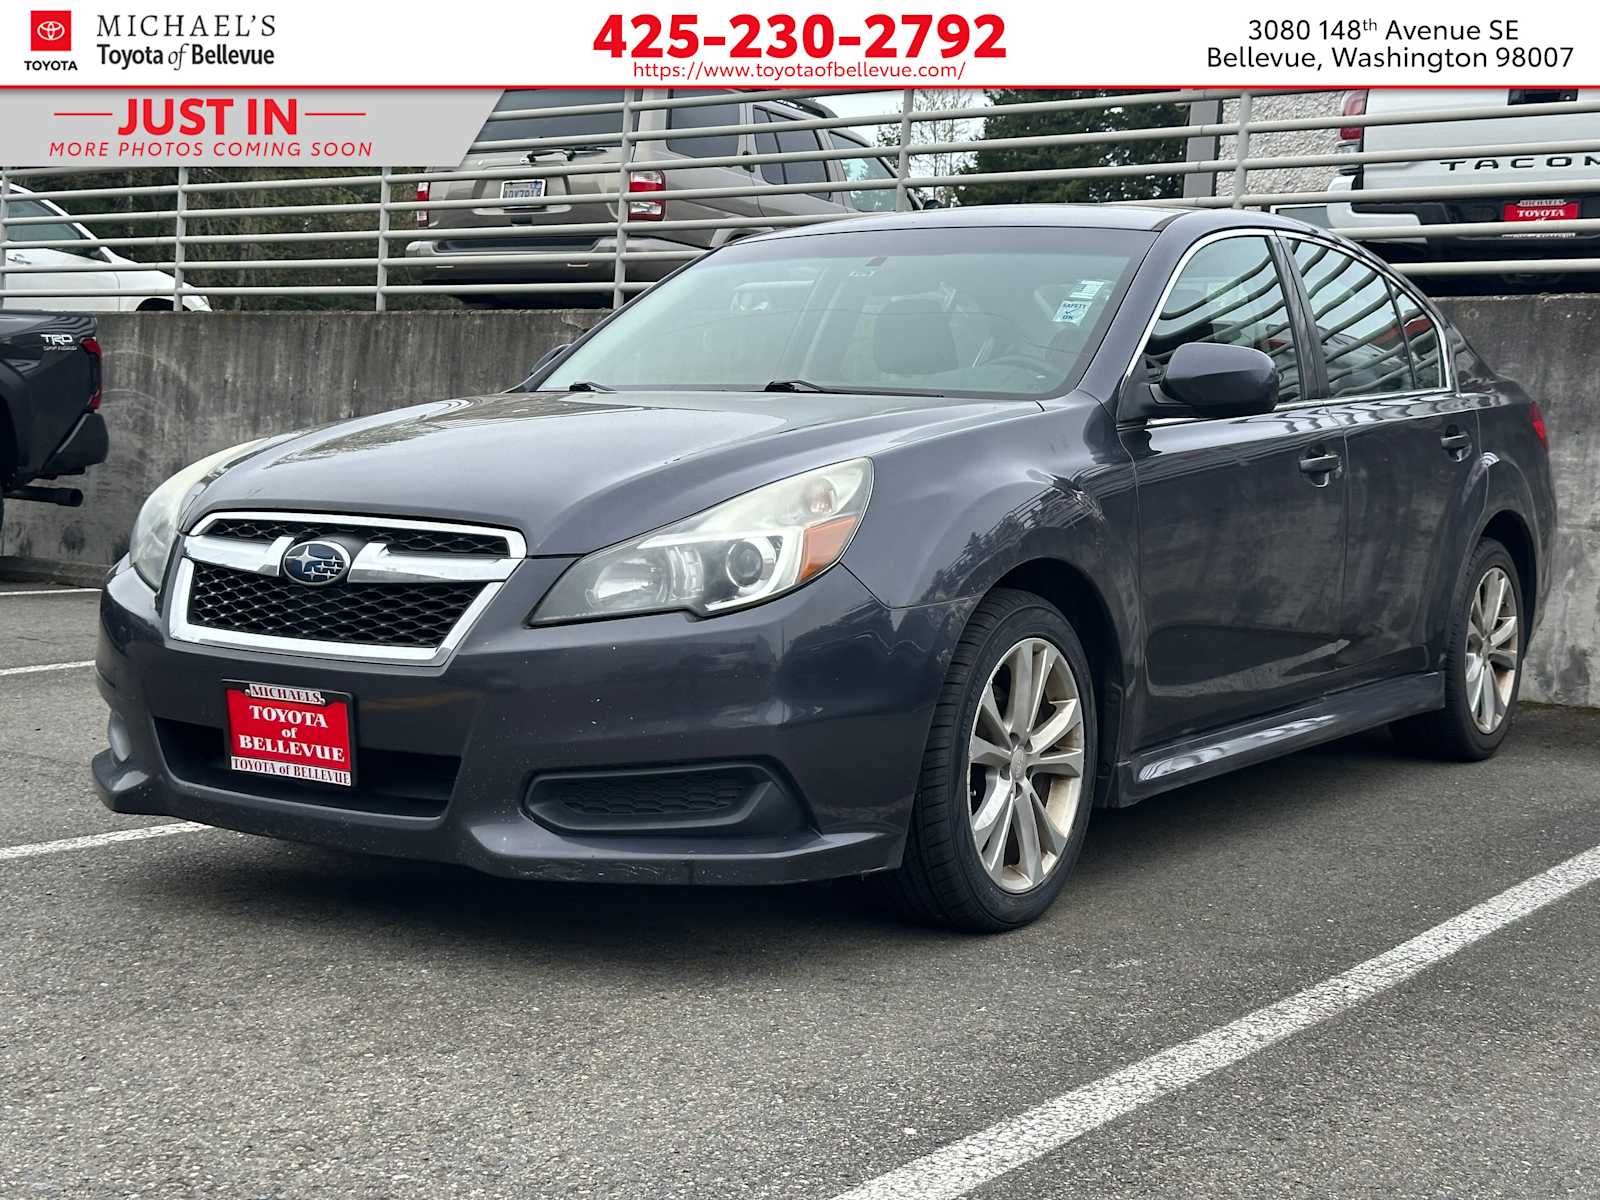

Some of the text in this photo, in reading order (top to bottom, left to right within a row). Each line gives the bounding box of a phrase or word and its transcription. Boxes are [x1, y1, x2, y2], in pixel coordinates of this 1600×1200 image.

[1517, 209, 1565, 217] TOYOTA
[40, 334, 73, 345] TRD
[249, 705, 328, 728] TOYOTA
[281, 727, 298, 738] of
[238, 734, 345, 762] BELLEVUE
[233, 758, 350, 785] TOYOTA of BELLEVUE
